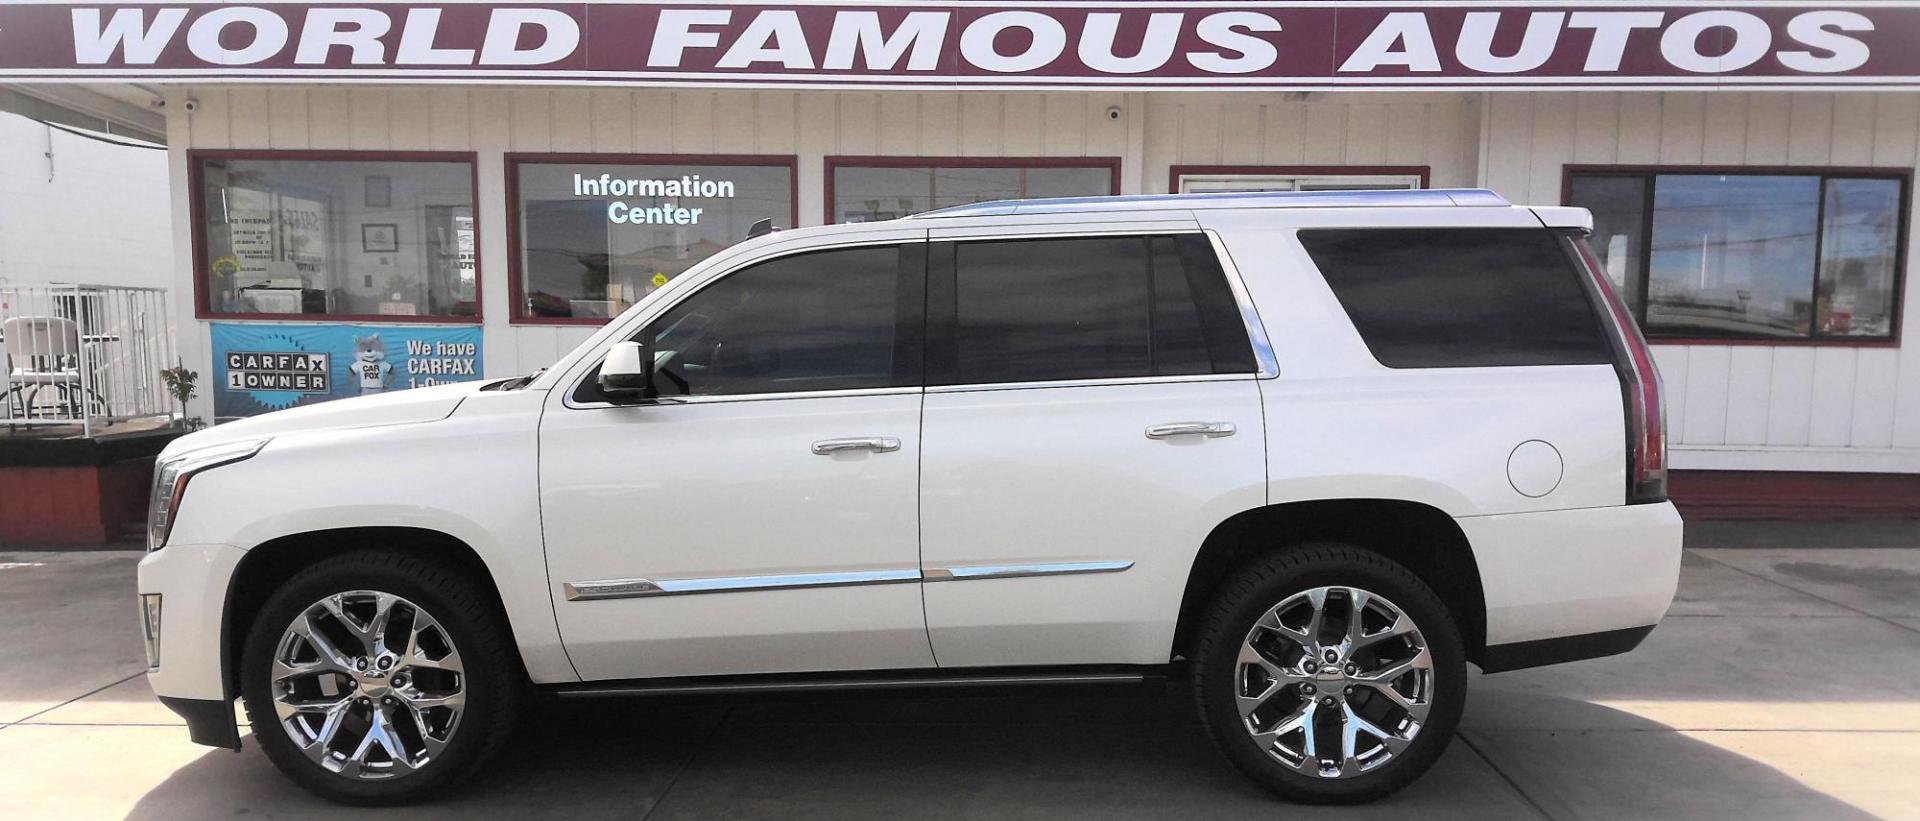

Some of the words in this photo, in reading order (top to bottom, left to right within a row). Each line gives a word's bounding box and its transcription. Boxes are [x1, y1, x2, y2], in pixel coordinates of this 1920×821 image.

[71, 7, 580, 65] WORLD
[646, 9, 1283, 74] FAMOUS
[1337, 10, 1876, 74] AUTOS
[574, 173, 735, 198] Information
[608, 201, 703, 225] Center
[407, 340, 432, 356] We
[437, 340, 475, 356] have
[230, 354, 323, 371] CARFAX
[408, 358, 475, 374] CARFAX
